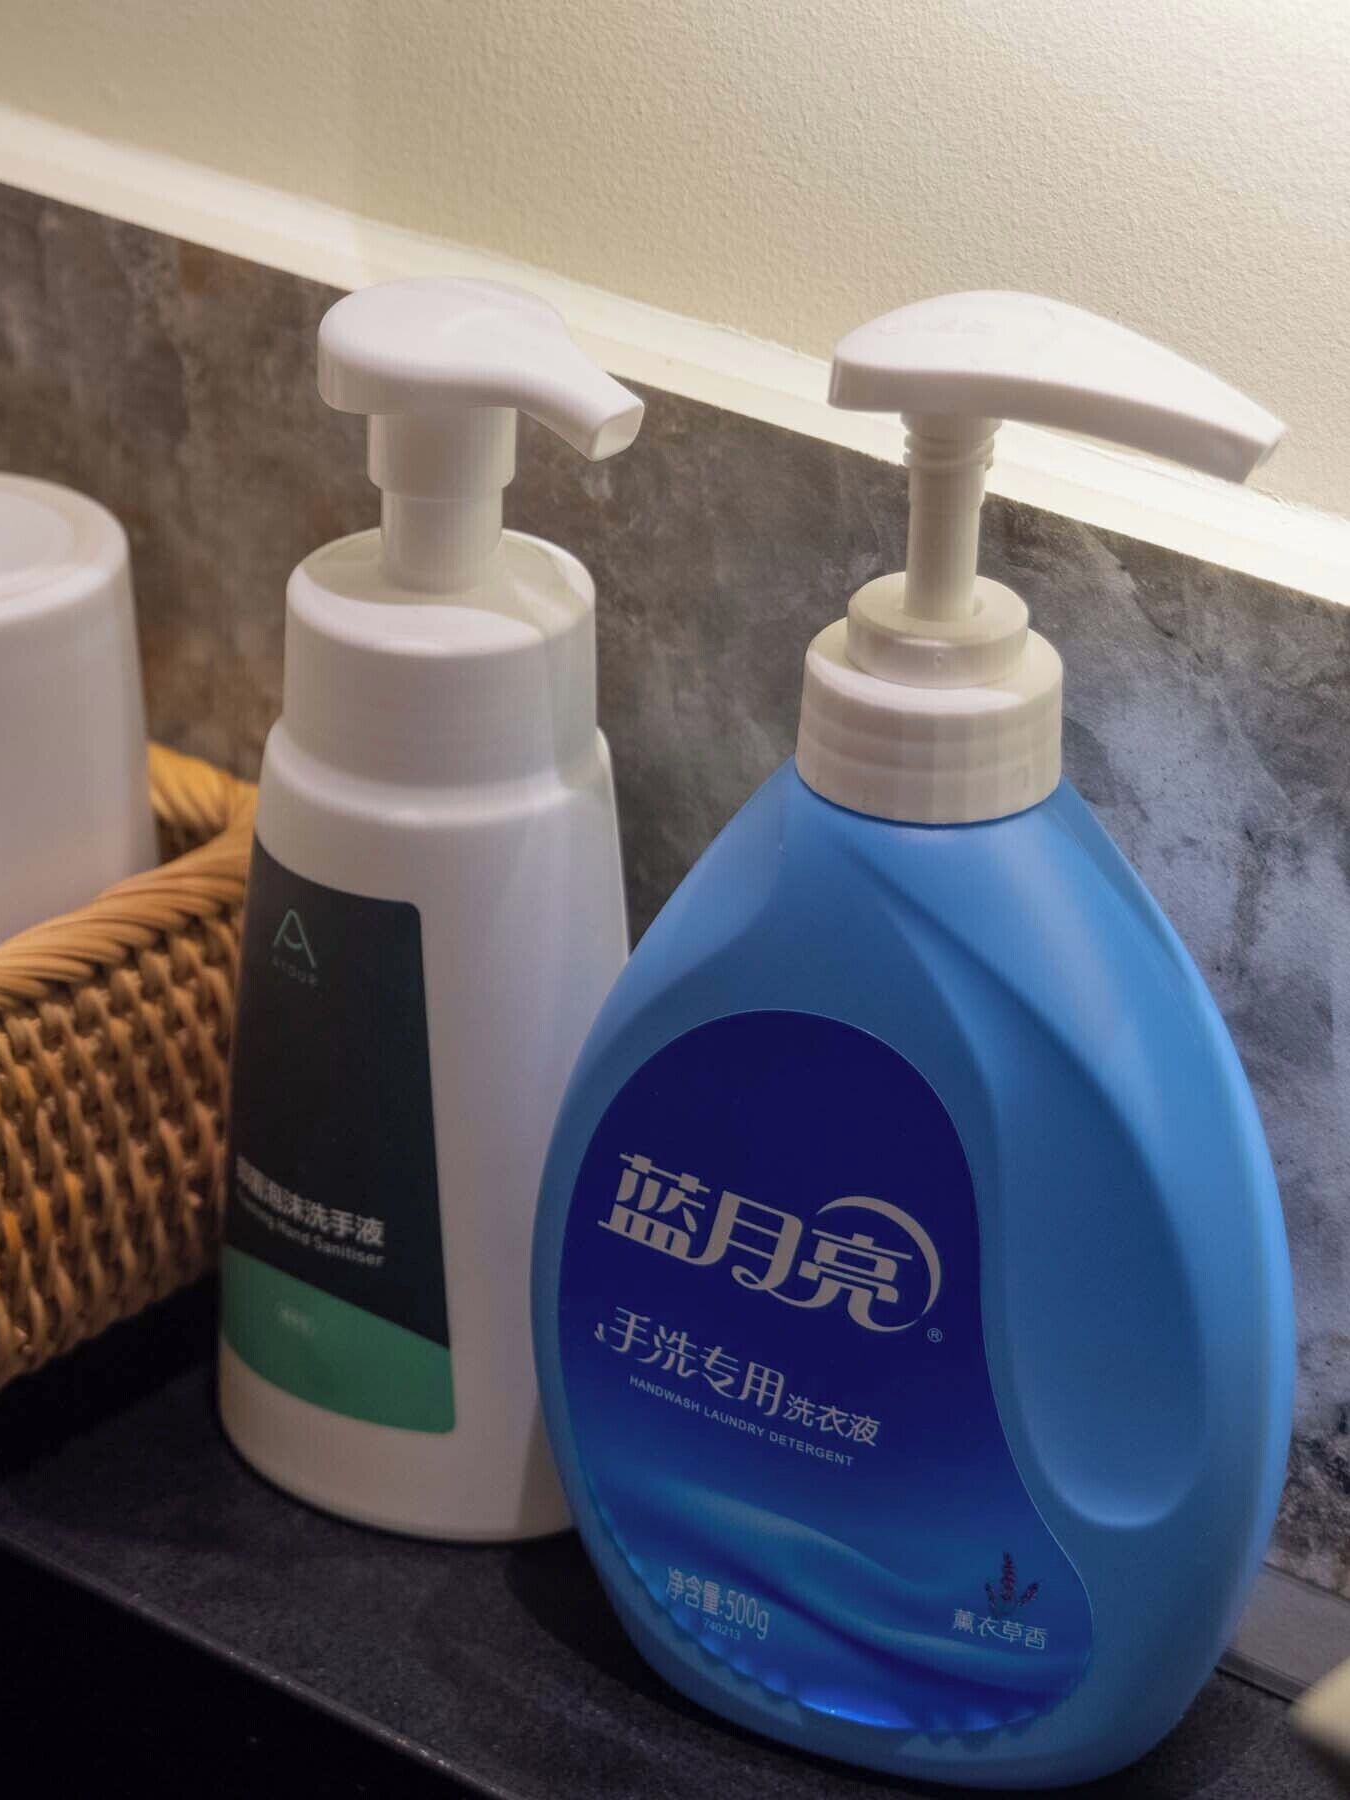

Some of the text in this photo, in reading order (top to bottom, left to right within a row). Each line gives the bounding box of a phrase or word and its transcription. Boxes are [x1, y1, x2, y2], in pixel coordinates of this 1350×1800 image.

[598, 1152, 941, 1333] 蓝月亮
[595, 1305, 882, 1448] 手洗专用洗衣液
[629, 1375, 855, 1467] HANDWASH LAUNDRY DETERGENT
